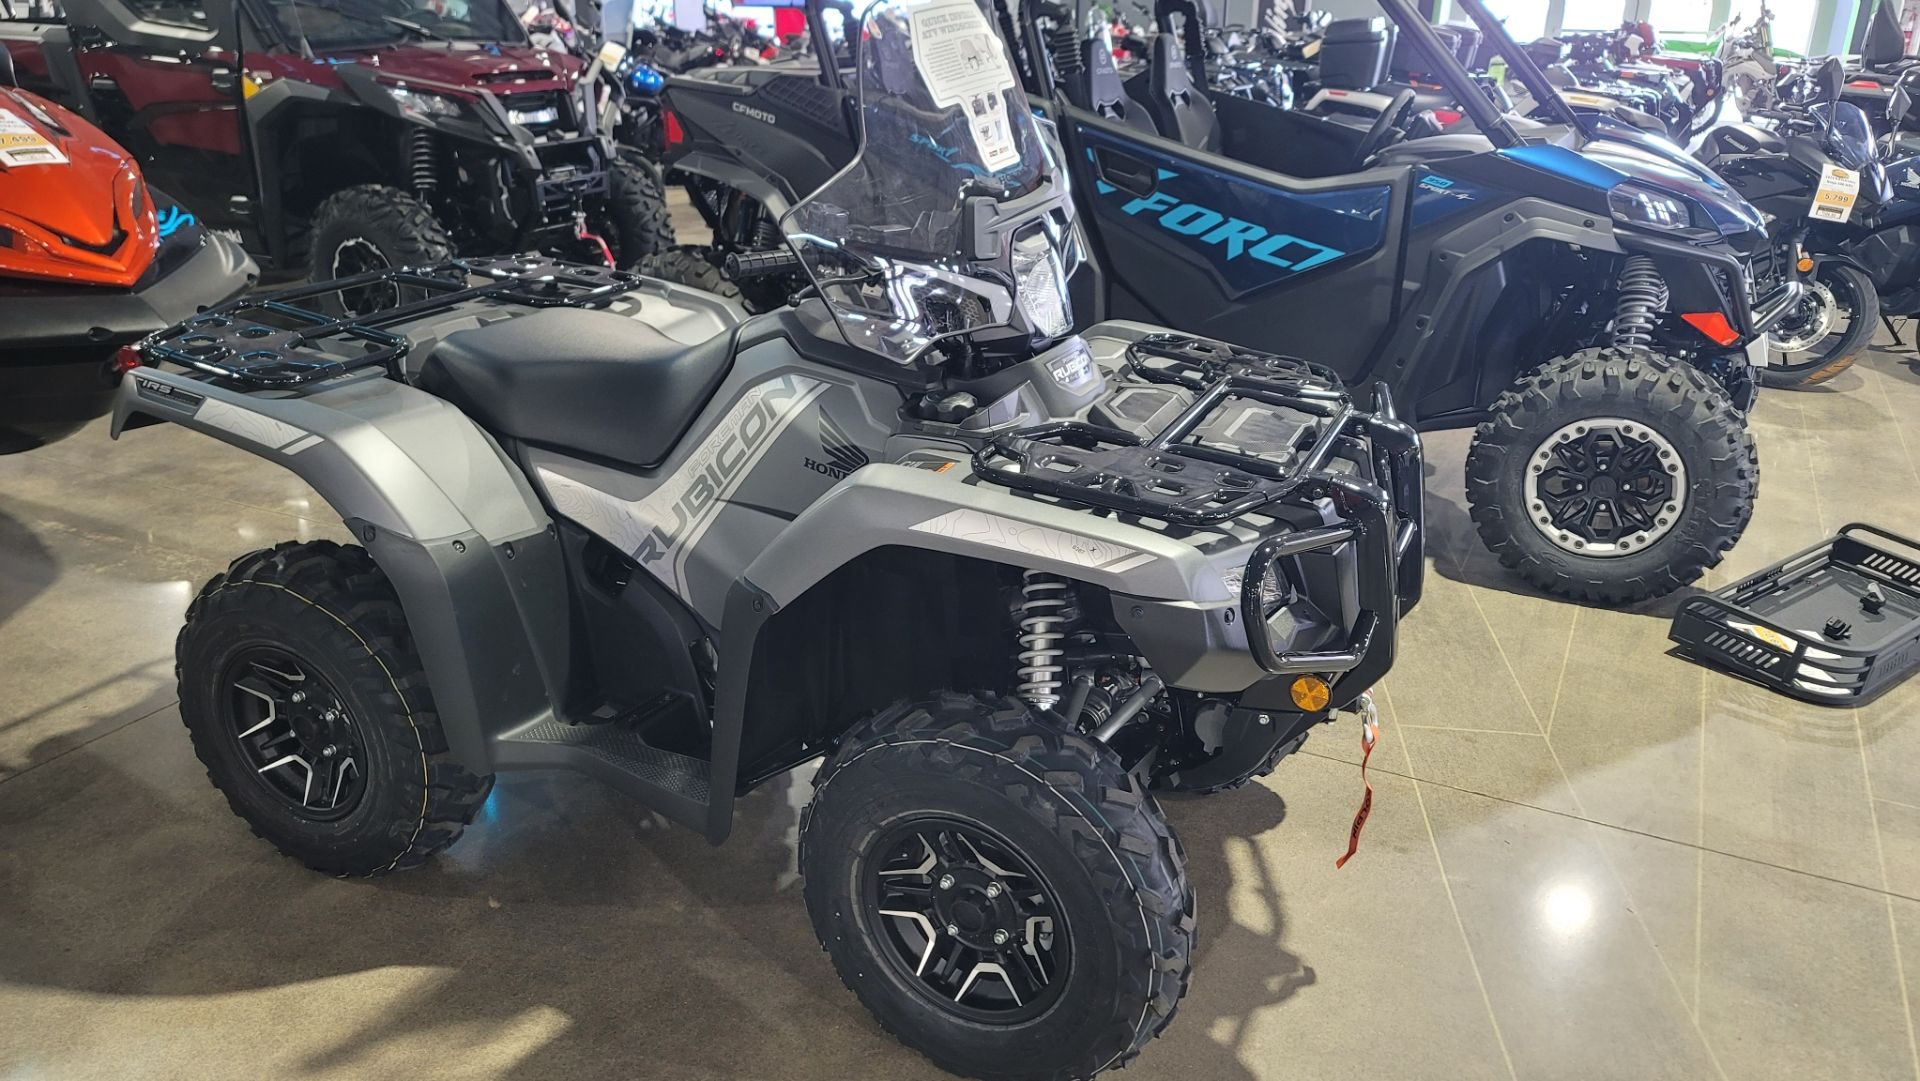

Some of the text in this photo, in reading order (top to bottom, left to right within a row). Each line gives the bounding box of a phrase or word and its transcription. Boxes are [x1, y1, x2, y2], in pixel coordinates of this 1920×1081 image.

[732, 101, 776, 124] CFMOTO
[1825, 194, 1849, 203] 5,799
[142, 379, 173, 395] IRS
[687, 386, 762, 479] FOREMAN
[631, 374, 798, 565] RUBICON
